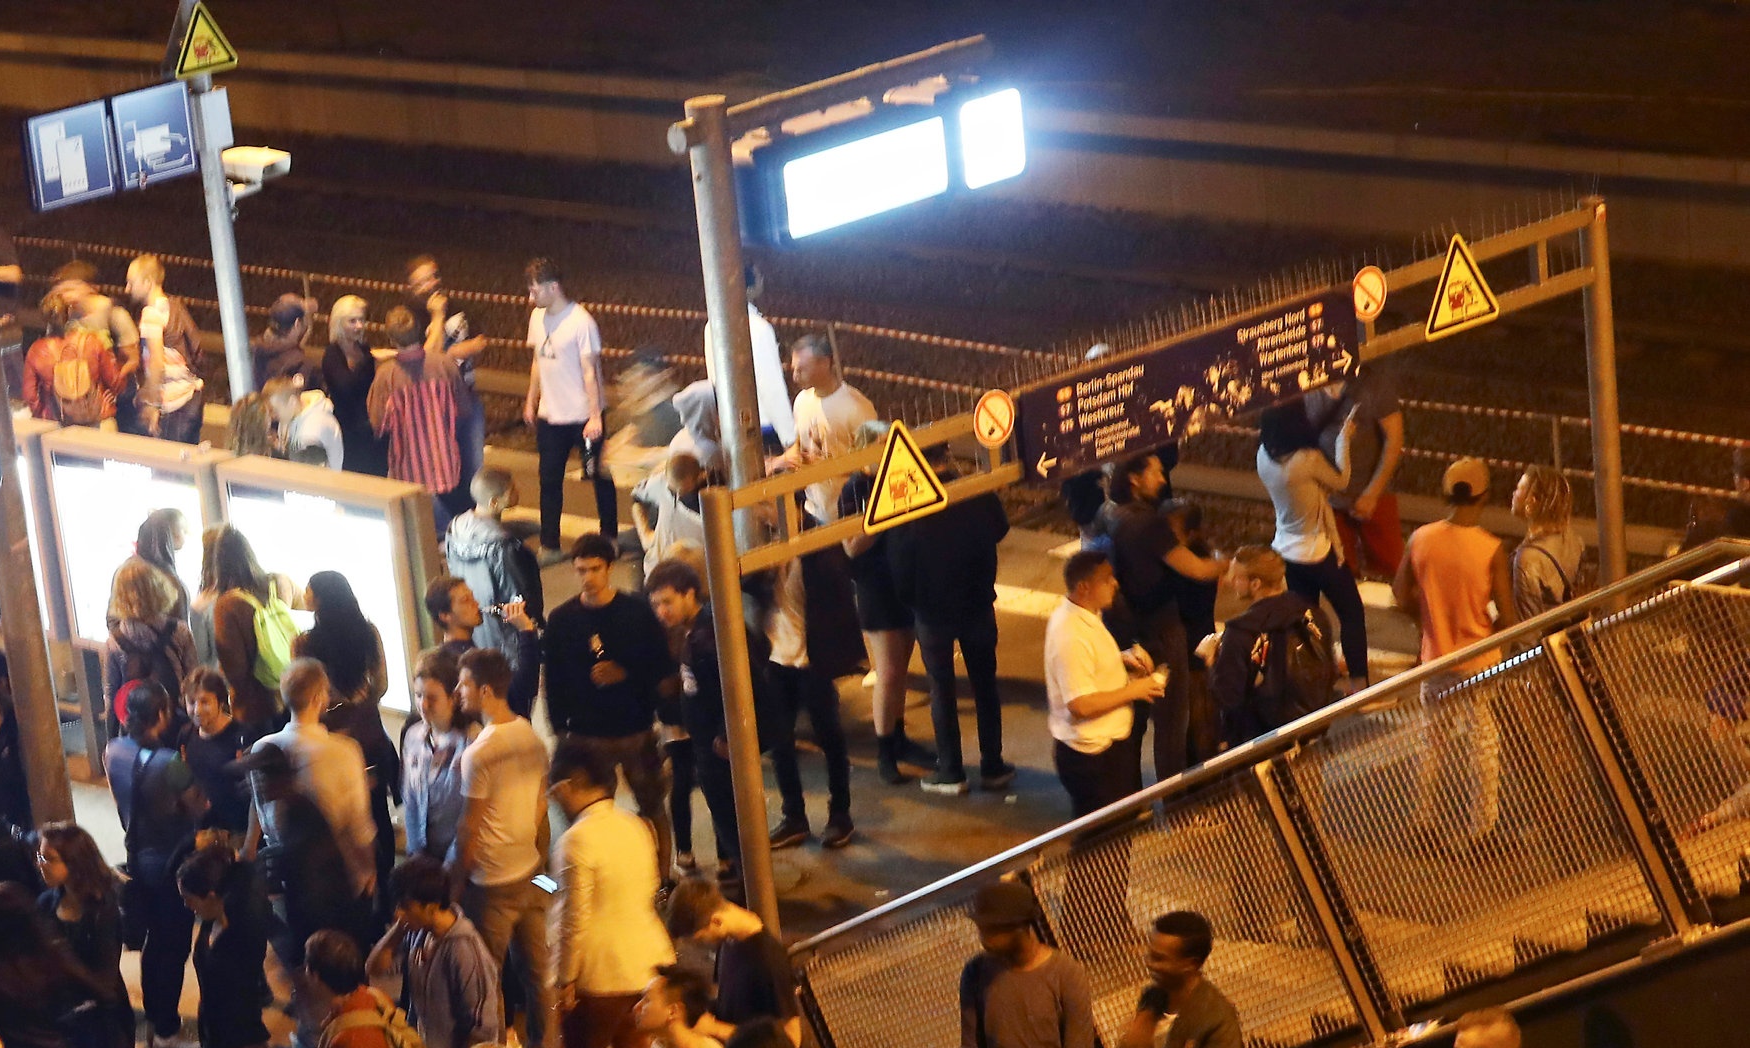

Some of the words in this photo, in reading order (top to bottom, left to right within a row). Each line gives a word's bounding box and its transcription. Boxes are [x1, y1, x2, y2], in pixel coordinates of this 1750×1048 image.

[1236, 316, 1284, 345] Strausberg
[1284, 307, 1306, 327] Nord
[1257, 323, 1307, 353] Ahrensfelde
[1259, 339, 1308, 368] Wartenberg
[1076, 363, 1144, 397] Berlin-Spandau
[1077, 388, 1116, 413] Potsdam
[1117, 380, 1134, 401] Hbf
[1078, 402, 1125, 430] Westkreuz
